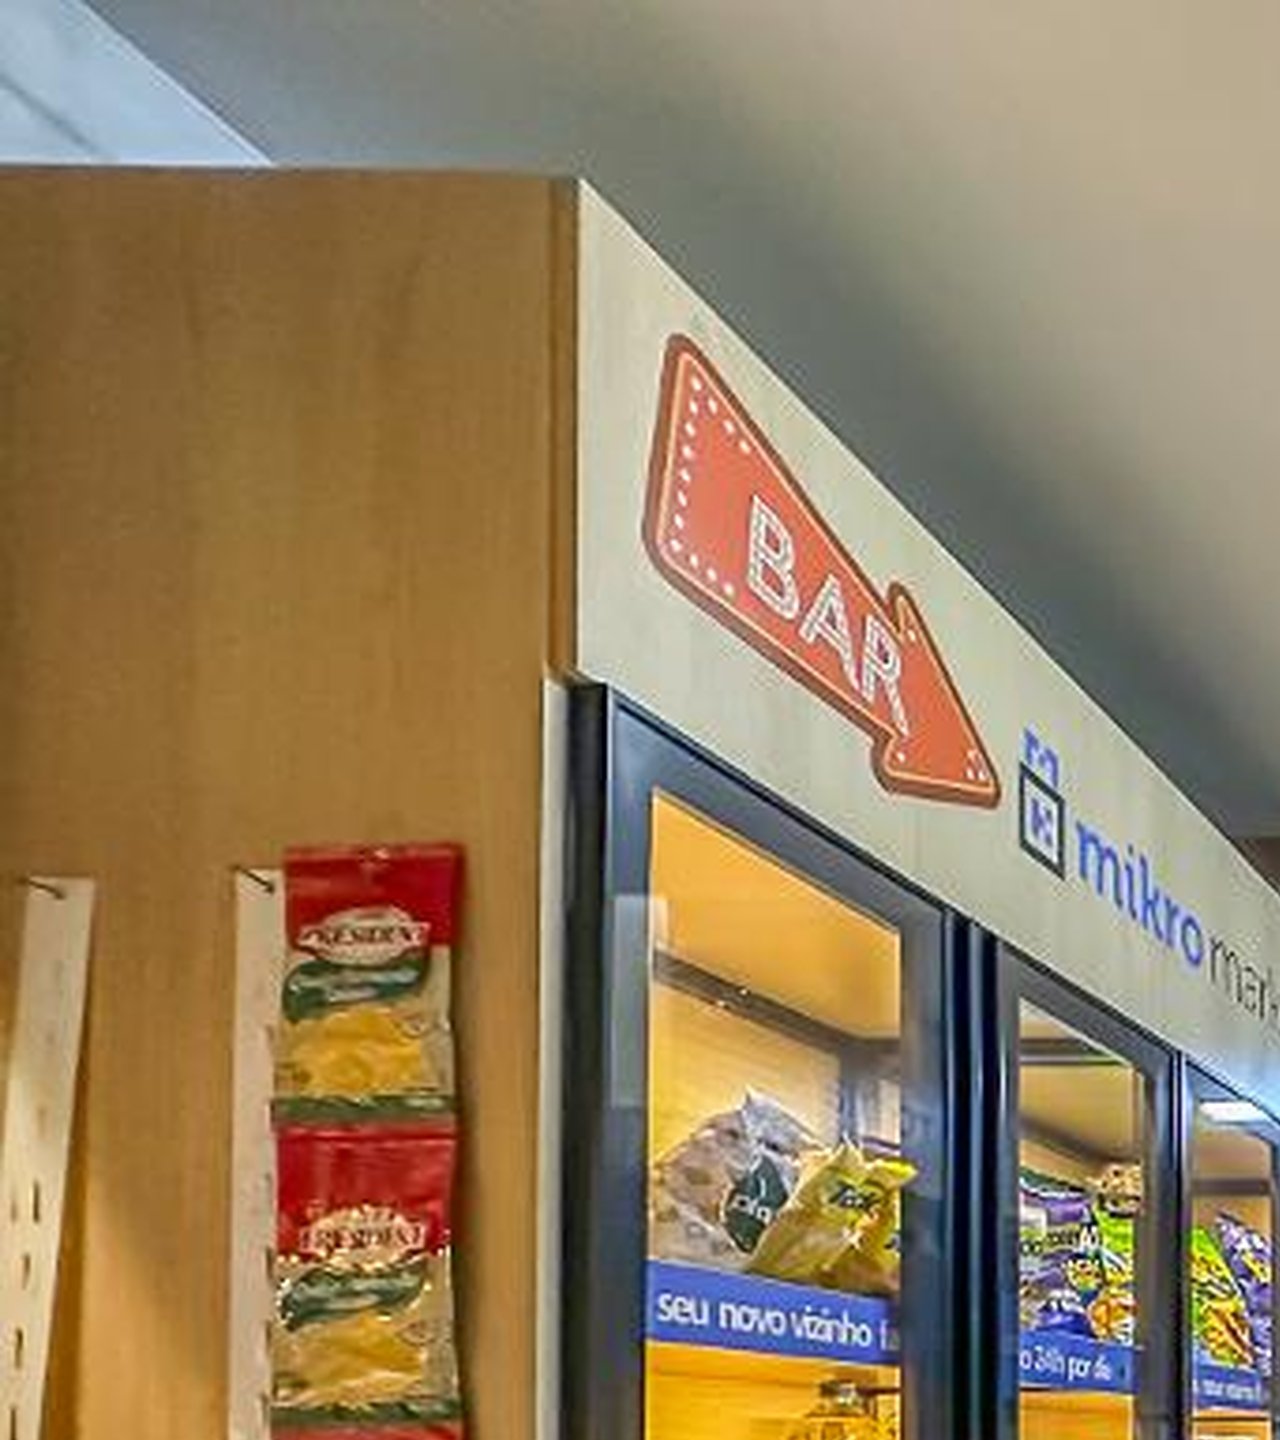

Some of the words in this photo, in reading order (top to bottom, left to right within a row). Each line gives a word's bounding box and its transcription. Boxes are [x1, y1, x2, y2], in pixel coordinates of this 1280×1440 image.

[747, 494, 909, 740] BAR
[1076, 819, 1204, 967] mikro
[657, 1293, 709, 1329] seu
[719, 1302, 787, 1336] novo
[791, 1306, 872, 1347] vizinho
